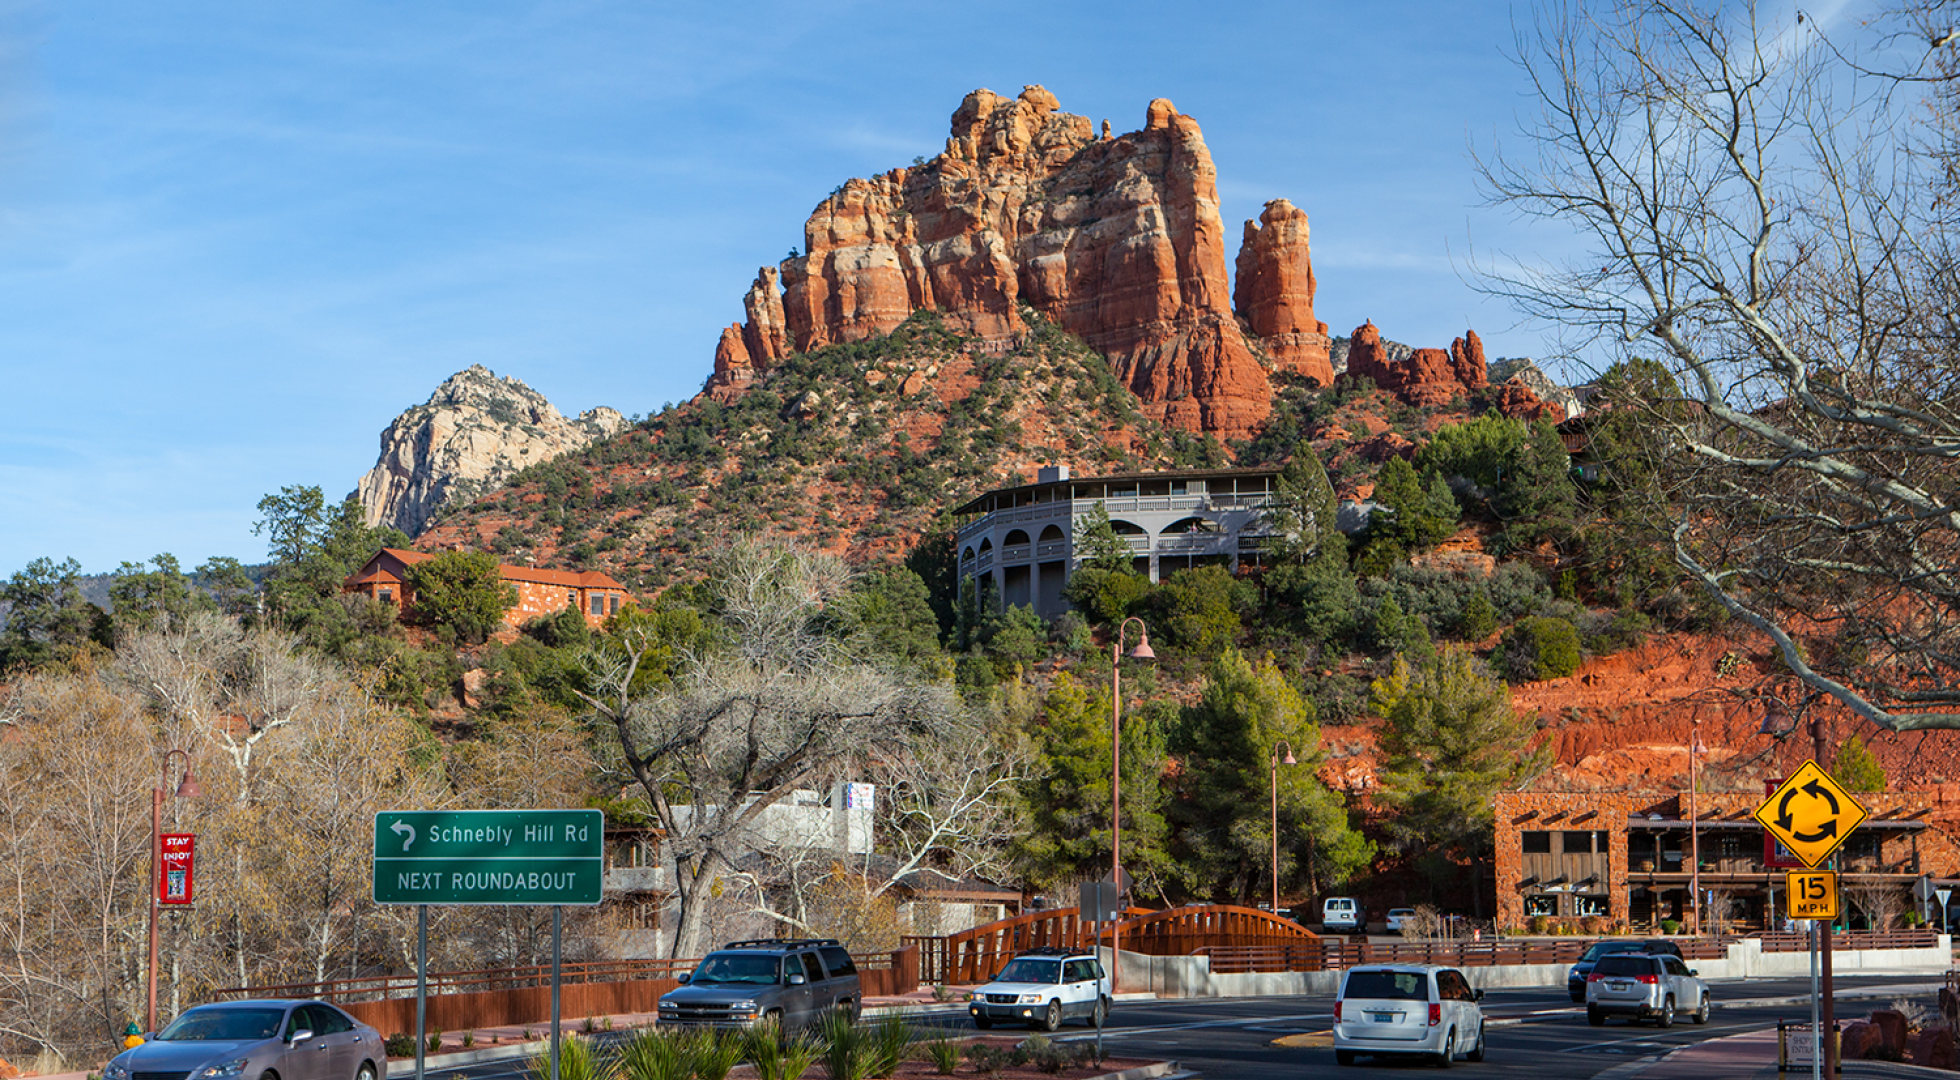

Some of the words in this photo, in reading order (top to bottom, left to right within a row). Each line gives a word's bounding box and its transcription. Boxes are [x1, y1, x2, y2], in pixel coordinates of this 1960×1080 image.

[166, 837, 190, 846] STAY
[429, 824, 513, 846] Schnebly
[524, 824, 554, 842] Hill
[565, 824, 588, 842] Rd
[163, 852, 191, 861] ENJOY
[398, 872, 443, 890] NEXT
[452, 872, 576, 890] ROUNDABOUT
[1797, 877, 1826, 900] 15
[1791, 1045, 1815, 1054] ENTRA
